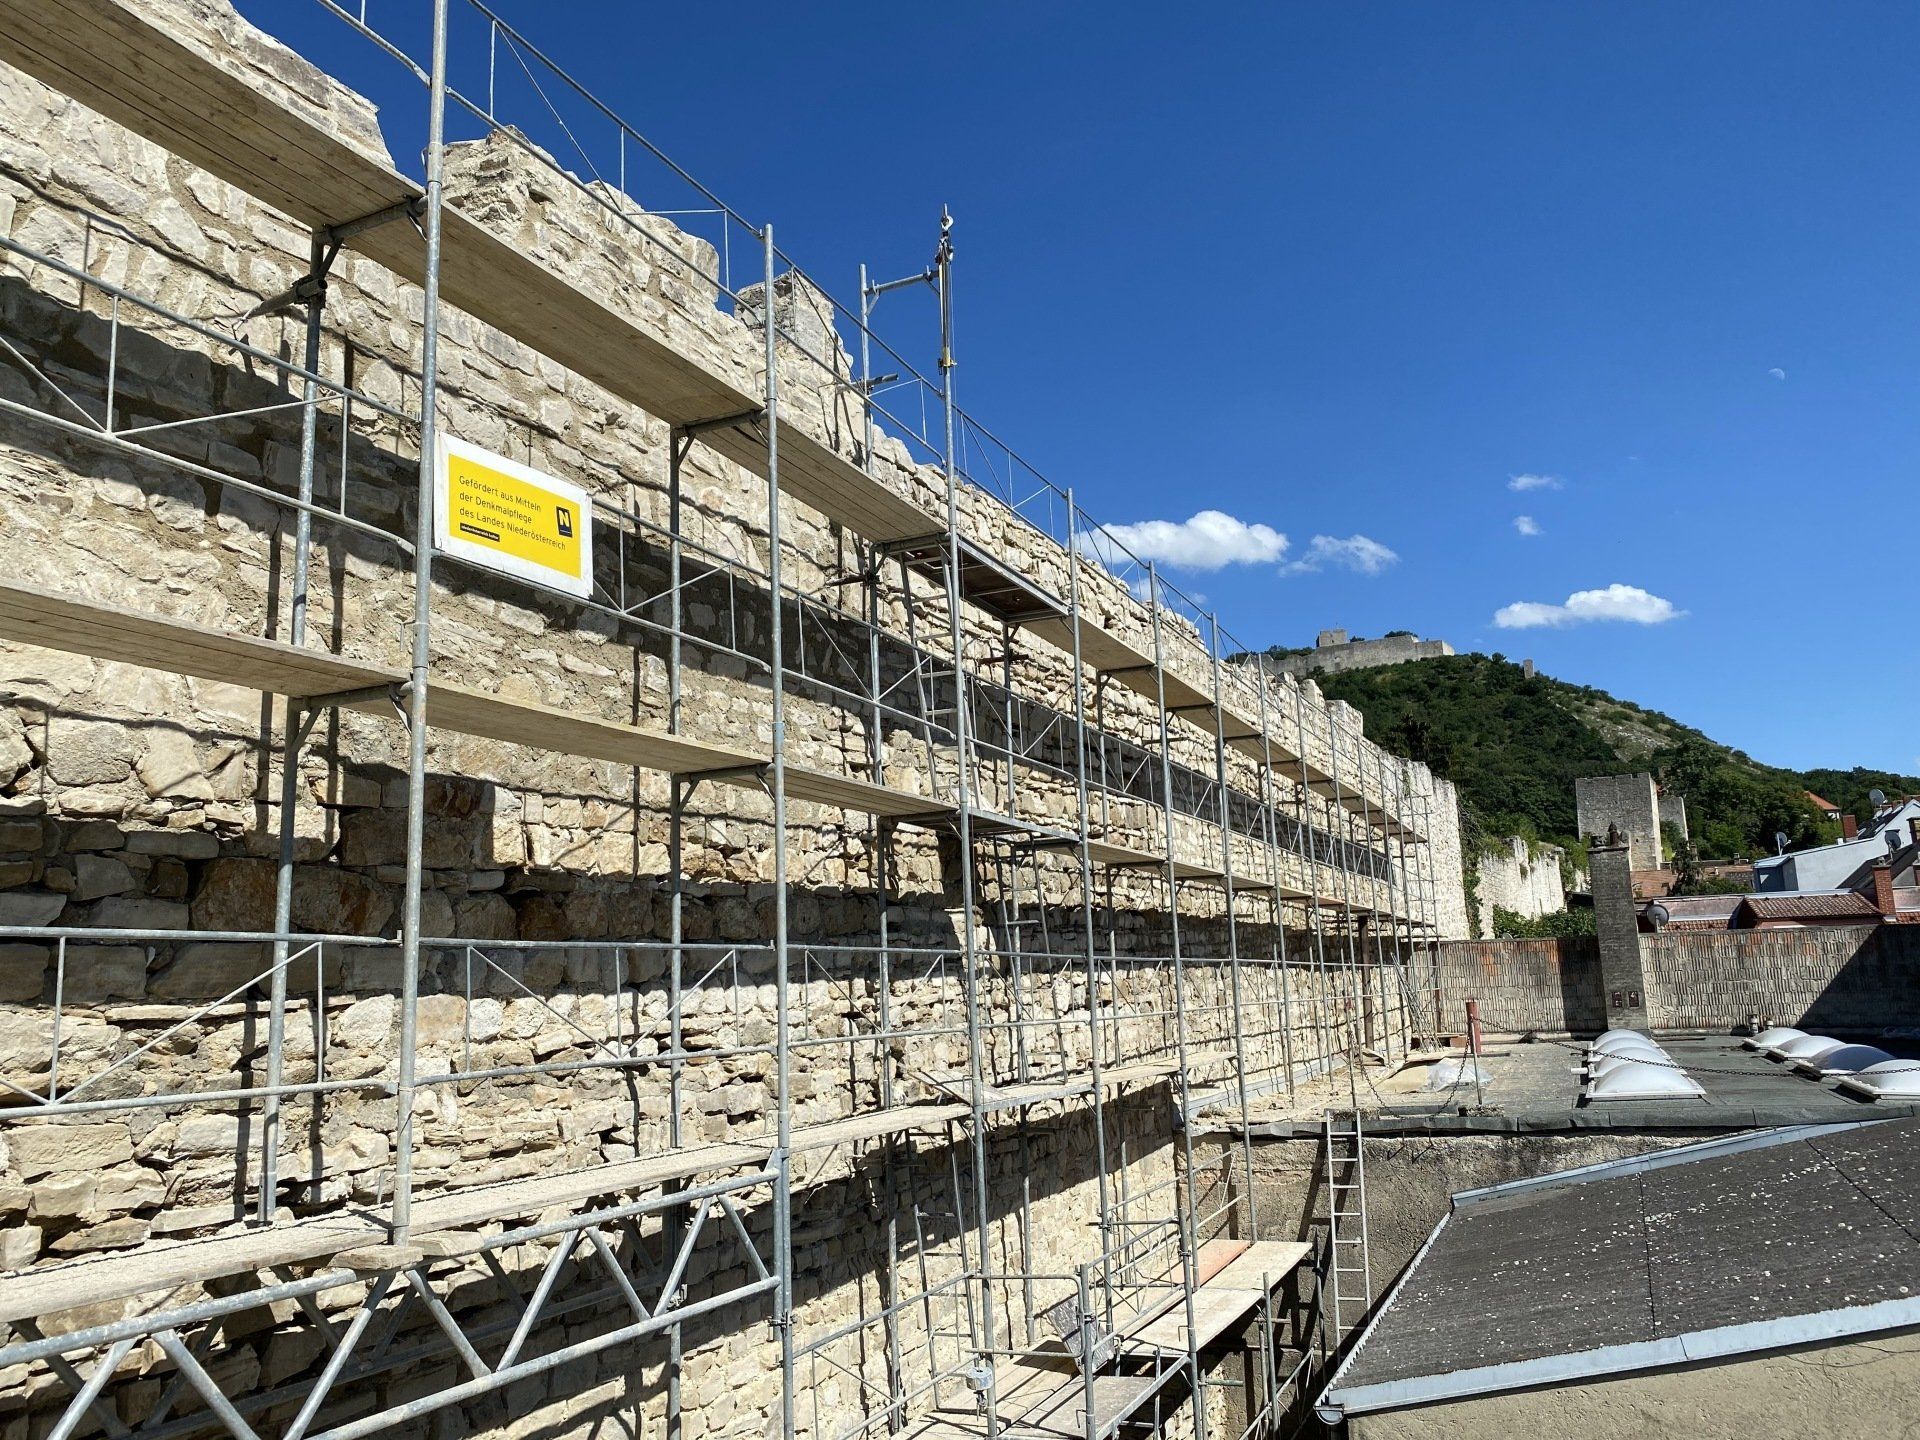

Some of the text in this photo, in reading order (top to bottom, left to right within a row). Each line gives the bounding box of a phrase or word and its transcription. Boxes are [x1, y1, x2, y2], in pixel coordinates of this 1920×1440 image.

[459, 475, 541, 512] Gefördert aus Mitteln
[460, 492, 532, 523] der Denkmalpflege
[460, 507, 474, 518] des
[477, 512, 504, 528] Landes
[507, 522, 566, 550] Niederösterreich
[558, 509, 570, 527] N
